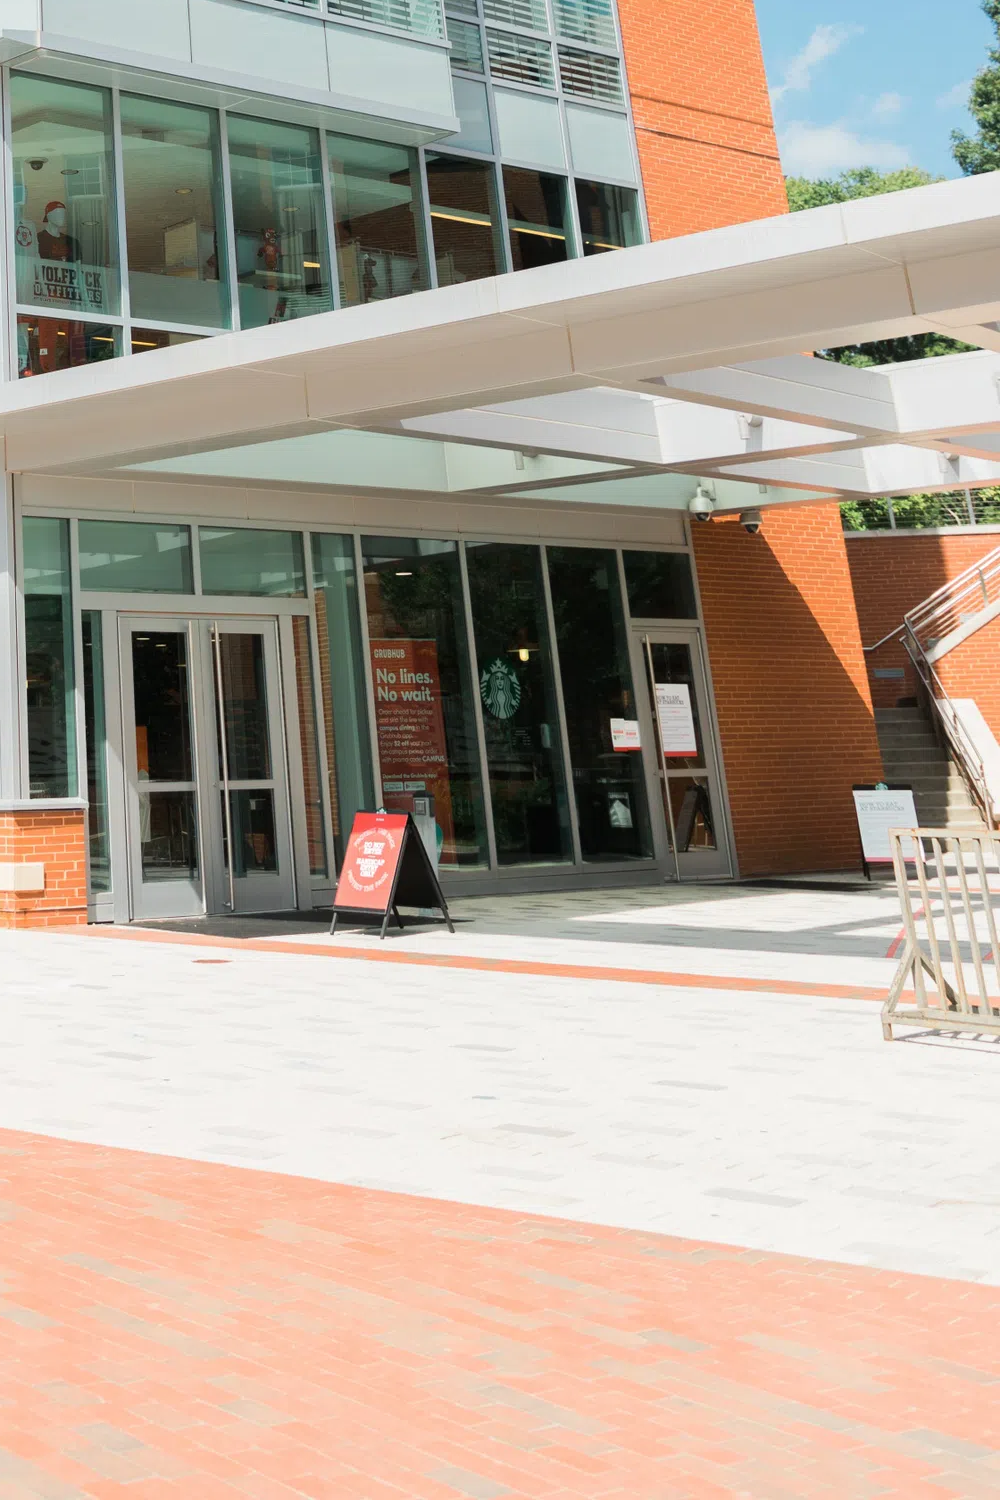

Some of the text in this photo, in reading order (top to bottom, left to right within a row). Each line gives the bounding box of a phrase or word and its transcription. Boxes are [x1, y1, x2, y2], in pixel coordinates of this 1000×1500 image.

[34, 264, 102, 288] OLFPCK
[34, 282, 102, 303] OTFITTRS
[373, 649, 406, 658] GRUBHUB
[376, 668, 434, 684] No lines.
[377, 686, 435, 702] No wait.
